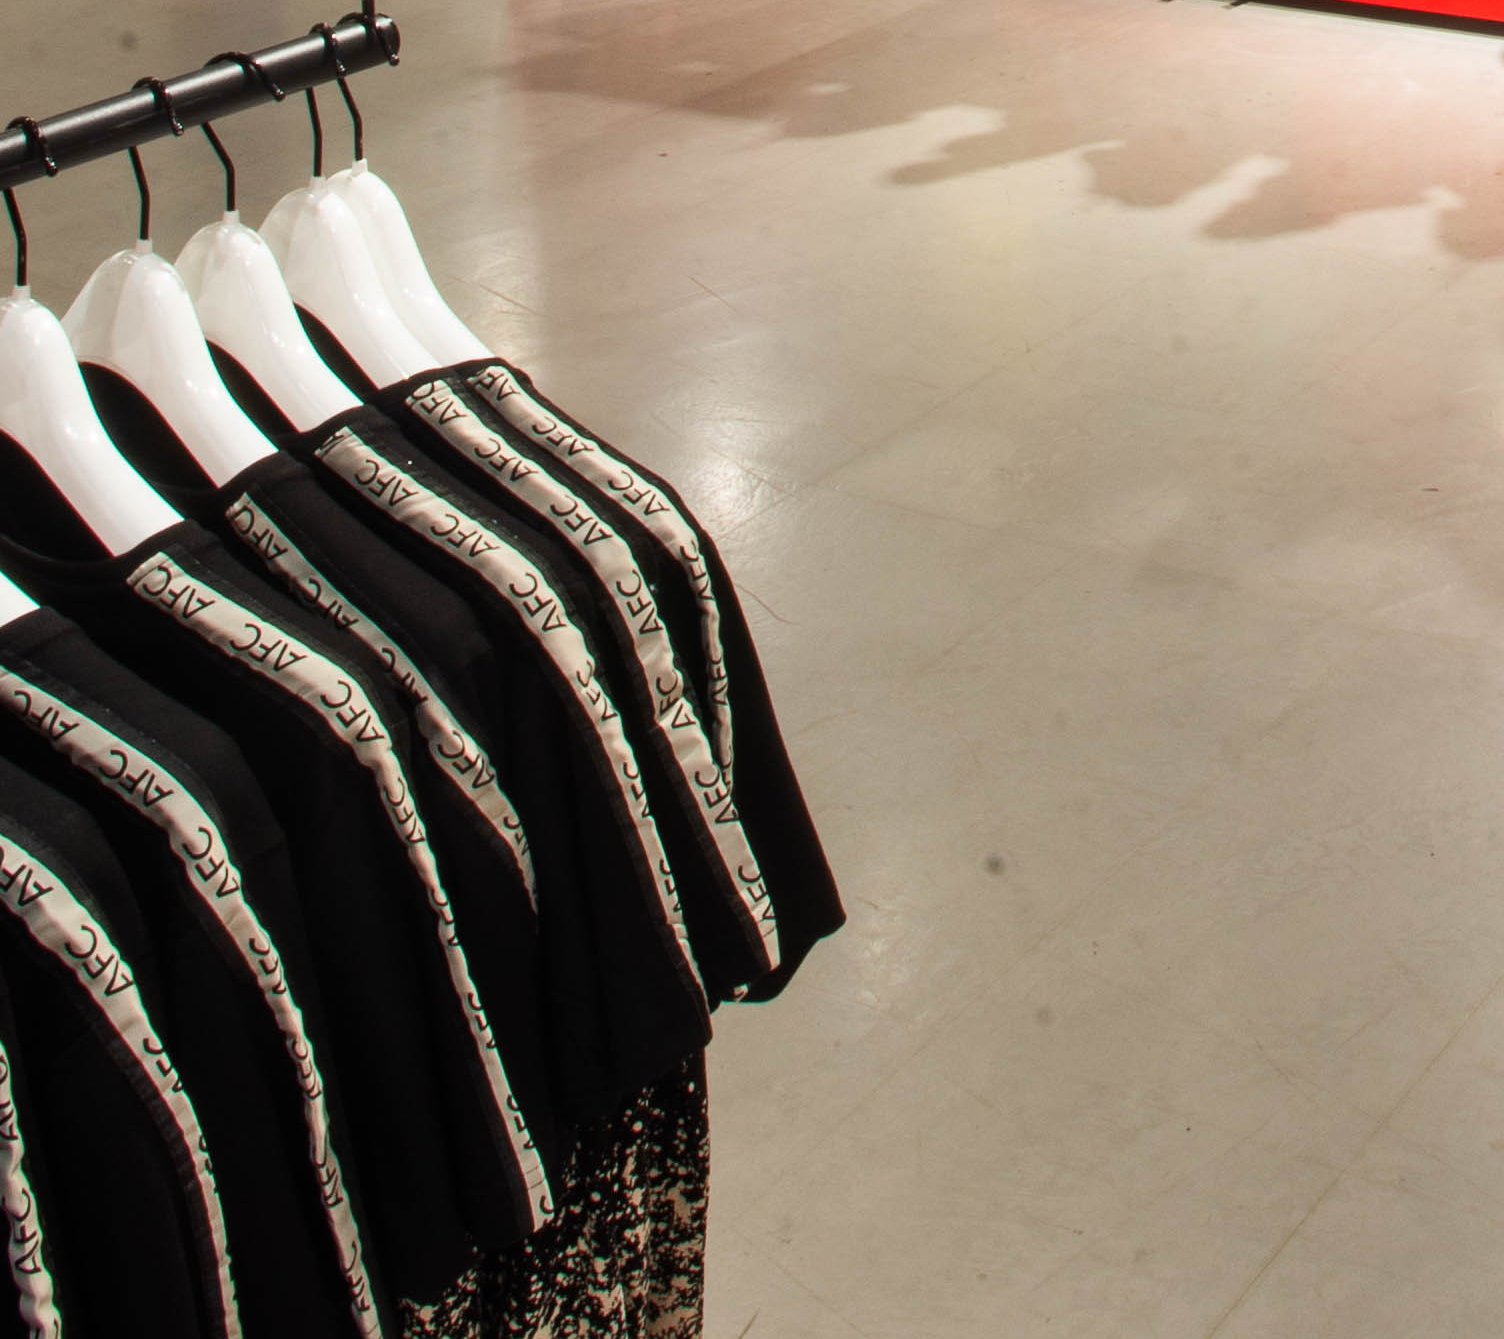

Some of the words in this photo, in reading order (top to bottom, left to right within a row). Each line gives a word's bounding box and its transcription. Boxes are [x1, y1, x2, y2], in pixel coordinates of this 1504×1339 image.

[473, 436, 540, 482] AFC
[530, 414, 595, 456] AFC
[352, 457, 421, 509] AFC
[606, 469, 671, 518] AFC
[435, 729, 495, 791] AFC
[382, 776, 427, 844] AFC
[694, 758, 740, 825] AFC
[181, 826, 241, 899] AFC
[64, 923, 135, 998] AFC
